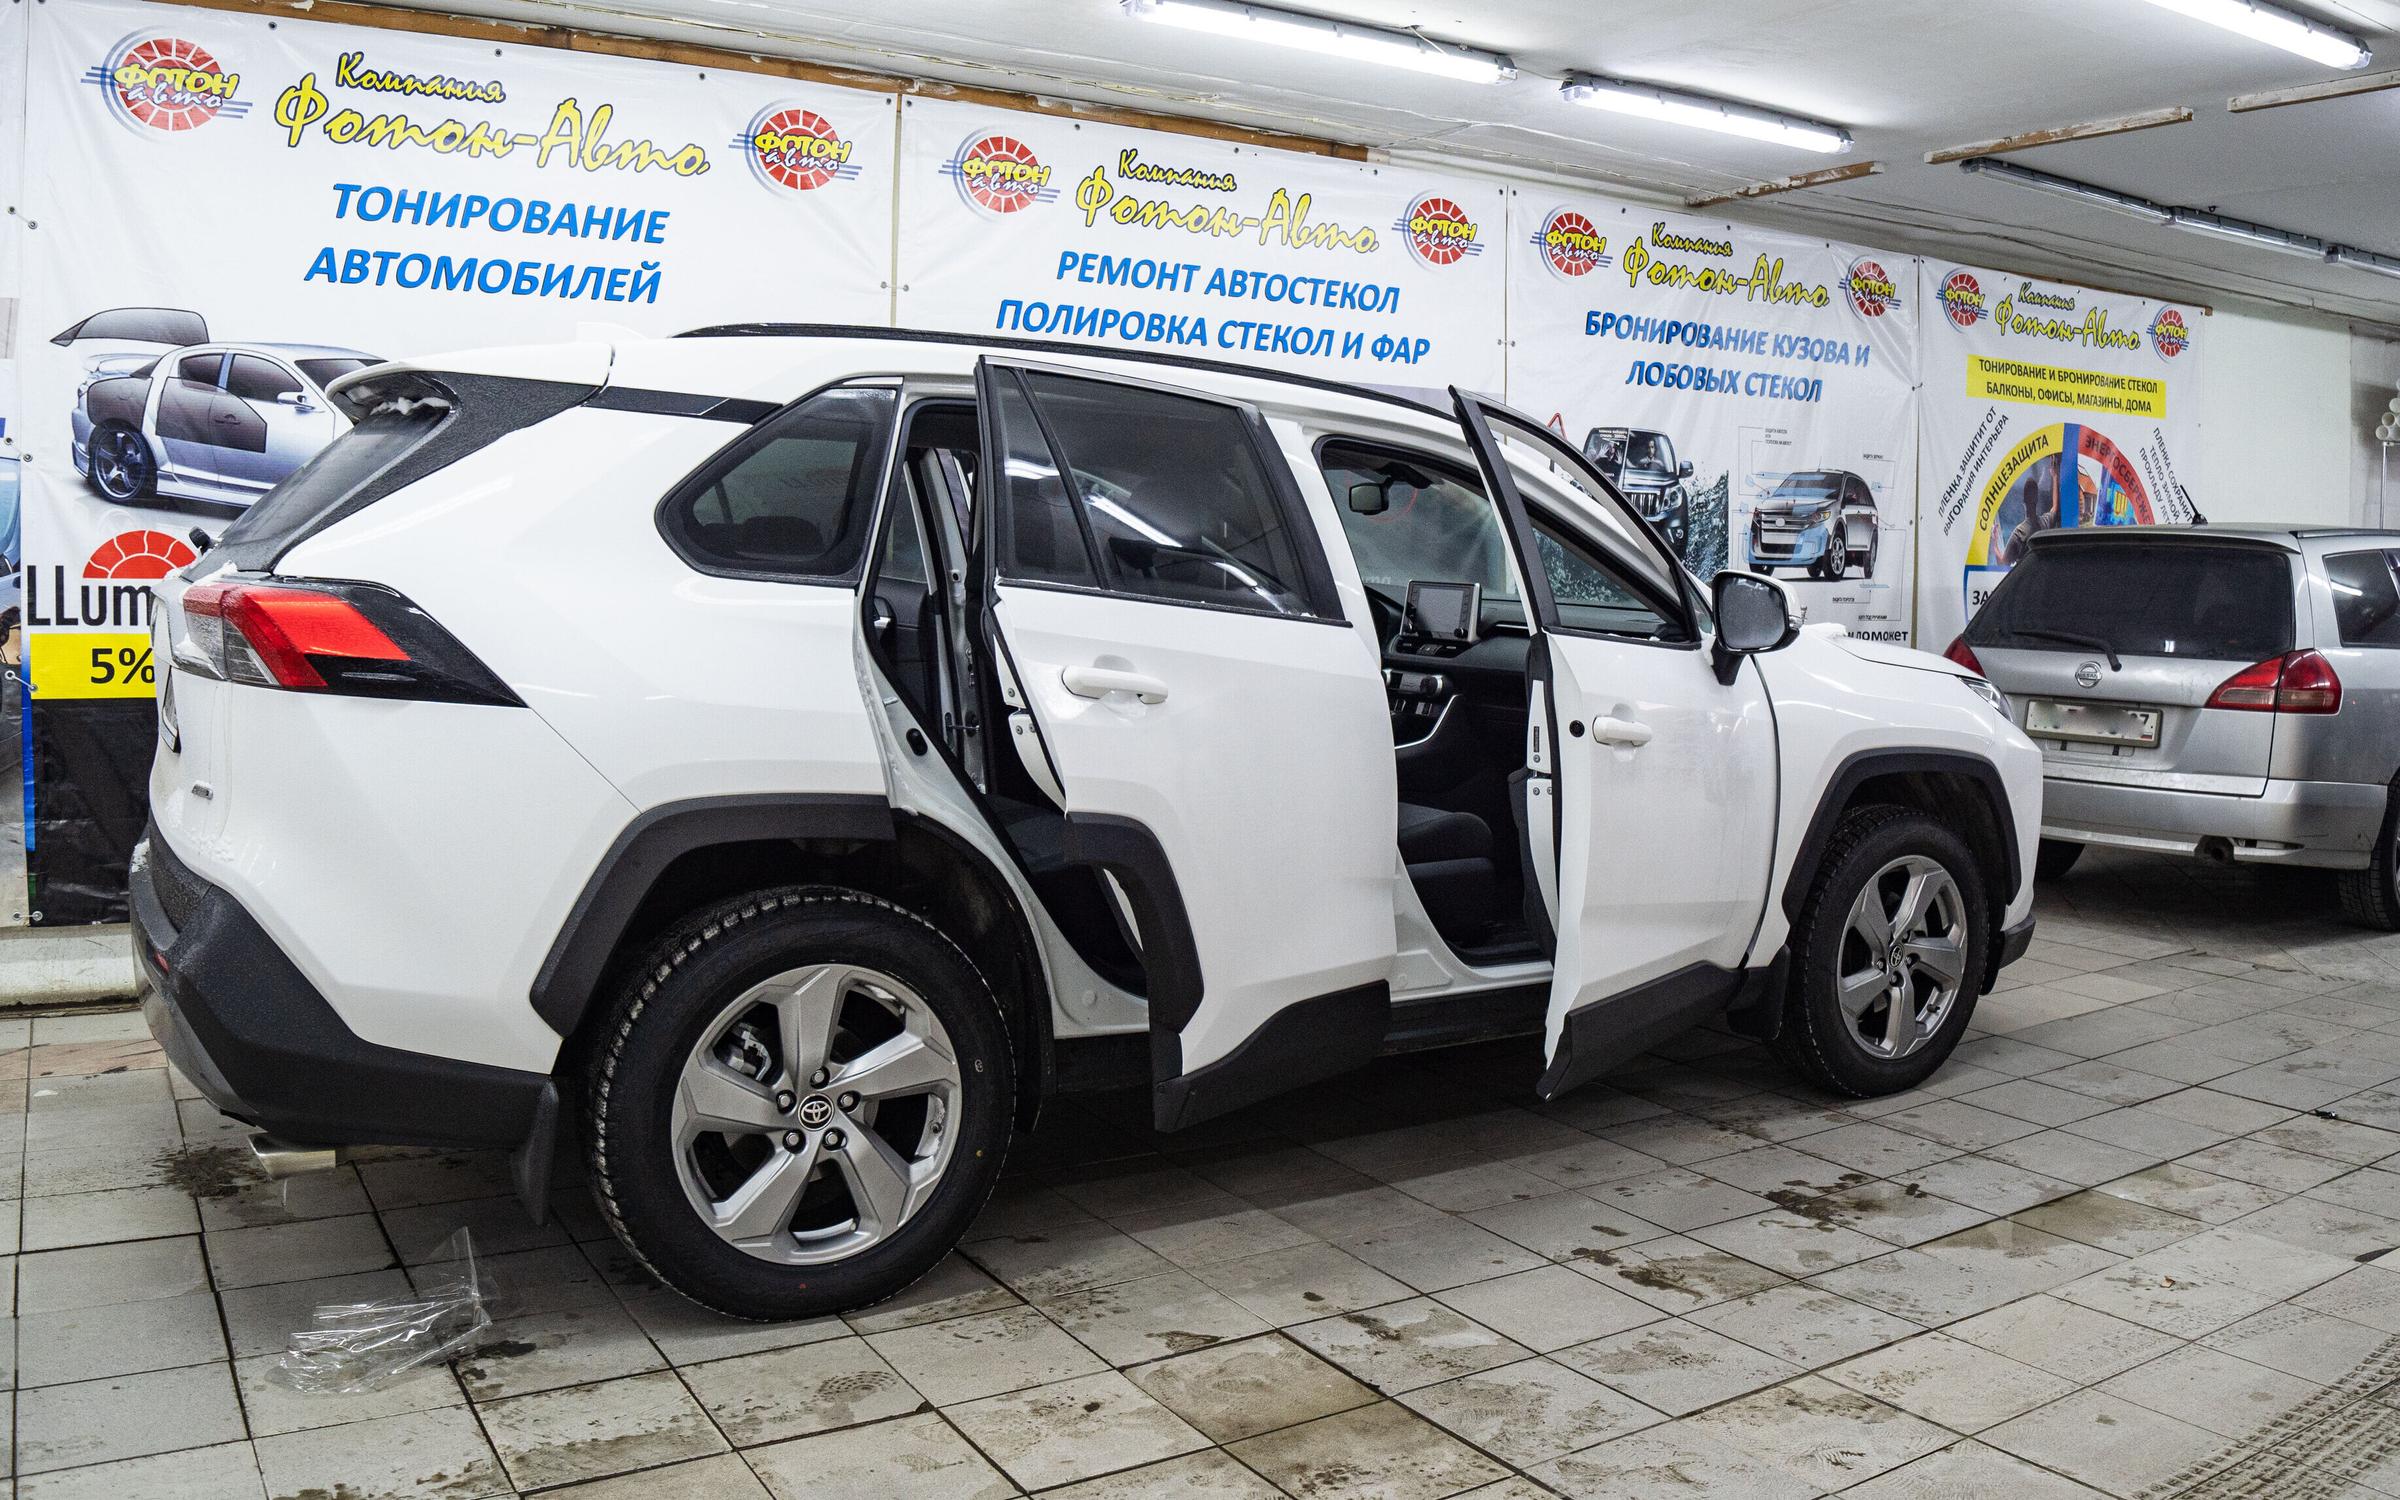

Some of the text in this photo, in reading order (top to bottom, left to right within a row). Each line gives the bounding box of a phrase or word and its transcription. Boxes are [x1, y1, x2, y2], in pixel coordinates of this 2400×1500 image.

[113, 62, 240, 98] ФОТОН
[126, 83, 223, 108] авто
[335, 52, 506, 103] Компания
[273, 72, 710, 176] Фотон-Авто
[753, 131, 852, 163] ФОТОН
[765, 147, 839, 171] авто
[962, 157, 1051, 187] ФОТОН
[1119, 149, 1237, 192] Компания
[971, 172, 1039, 195] авто
[333, 183, 671, 244] ТОНИРОВАНИЕ
[1076, 166, 1379, 253] Фотон-Авто
[1409, 216, 1478, 242] ФОТОН
[1545, 228, 1607, 254] ФОТОН
[1651, 222, 1734, 256] Компания
[304, 246, 661, 304] АВТОМОБИЛЕЙ
[1056, 251, 1400, 314] РЕМОНТ АВТОСТЕКОЛ
[1622, 236, 1830, 308] Фотон-Авто
[1851, 276, 1896, 298] ФОТОН
[1944, 287, 1985, 308] ФОТОН
[2018, 281, 2076, 311] Компания
[996, 299, 1430, 365] ПОЛИРОВКА СТЕКОЛ И ФАР
[1585, 310, 1870, 368] БРОНИРОВАНИЕ КУЗОВА И
[1995, 294, 2141, 350] Фотон-Авто
[1625, 360, 1823, 403] ЛОБОВЫХ СТЕКОЛ
[1978, 359, 2158, 394] ТОНИРОВАНИЕ И БРОНИРОВАНИЕ СТЕКОЛ
[1986, 381, 2152, 412] БАЛКОНЫ, ОФИСЫ, МАГАЗИНЫ, ДОМА
[1938, 406, 1997, 518] ПЛЕНКА ЗАЩИТИТ ОТ
[1943, 414, 2009, 536] ВЫГОРАНИЯ ИНТЕРЬЕРА
[1979, 434, 2049, 531] СОЛНЦЕЗАЩИТА
[2085, 435, 2153, 525] ЭНЕРГОСБЕРЕЖЕ
[2149, 445, 2181, 522] ТЕПЛО ЗИМОЙ
[2153, 427, 2193, 522] ПЛЕНКА СОХРАНИТ
[2139, 447, 2171, 525] ПРОХЛАДУ ЛЕТ
[90, 647, 155, 684] 5%
